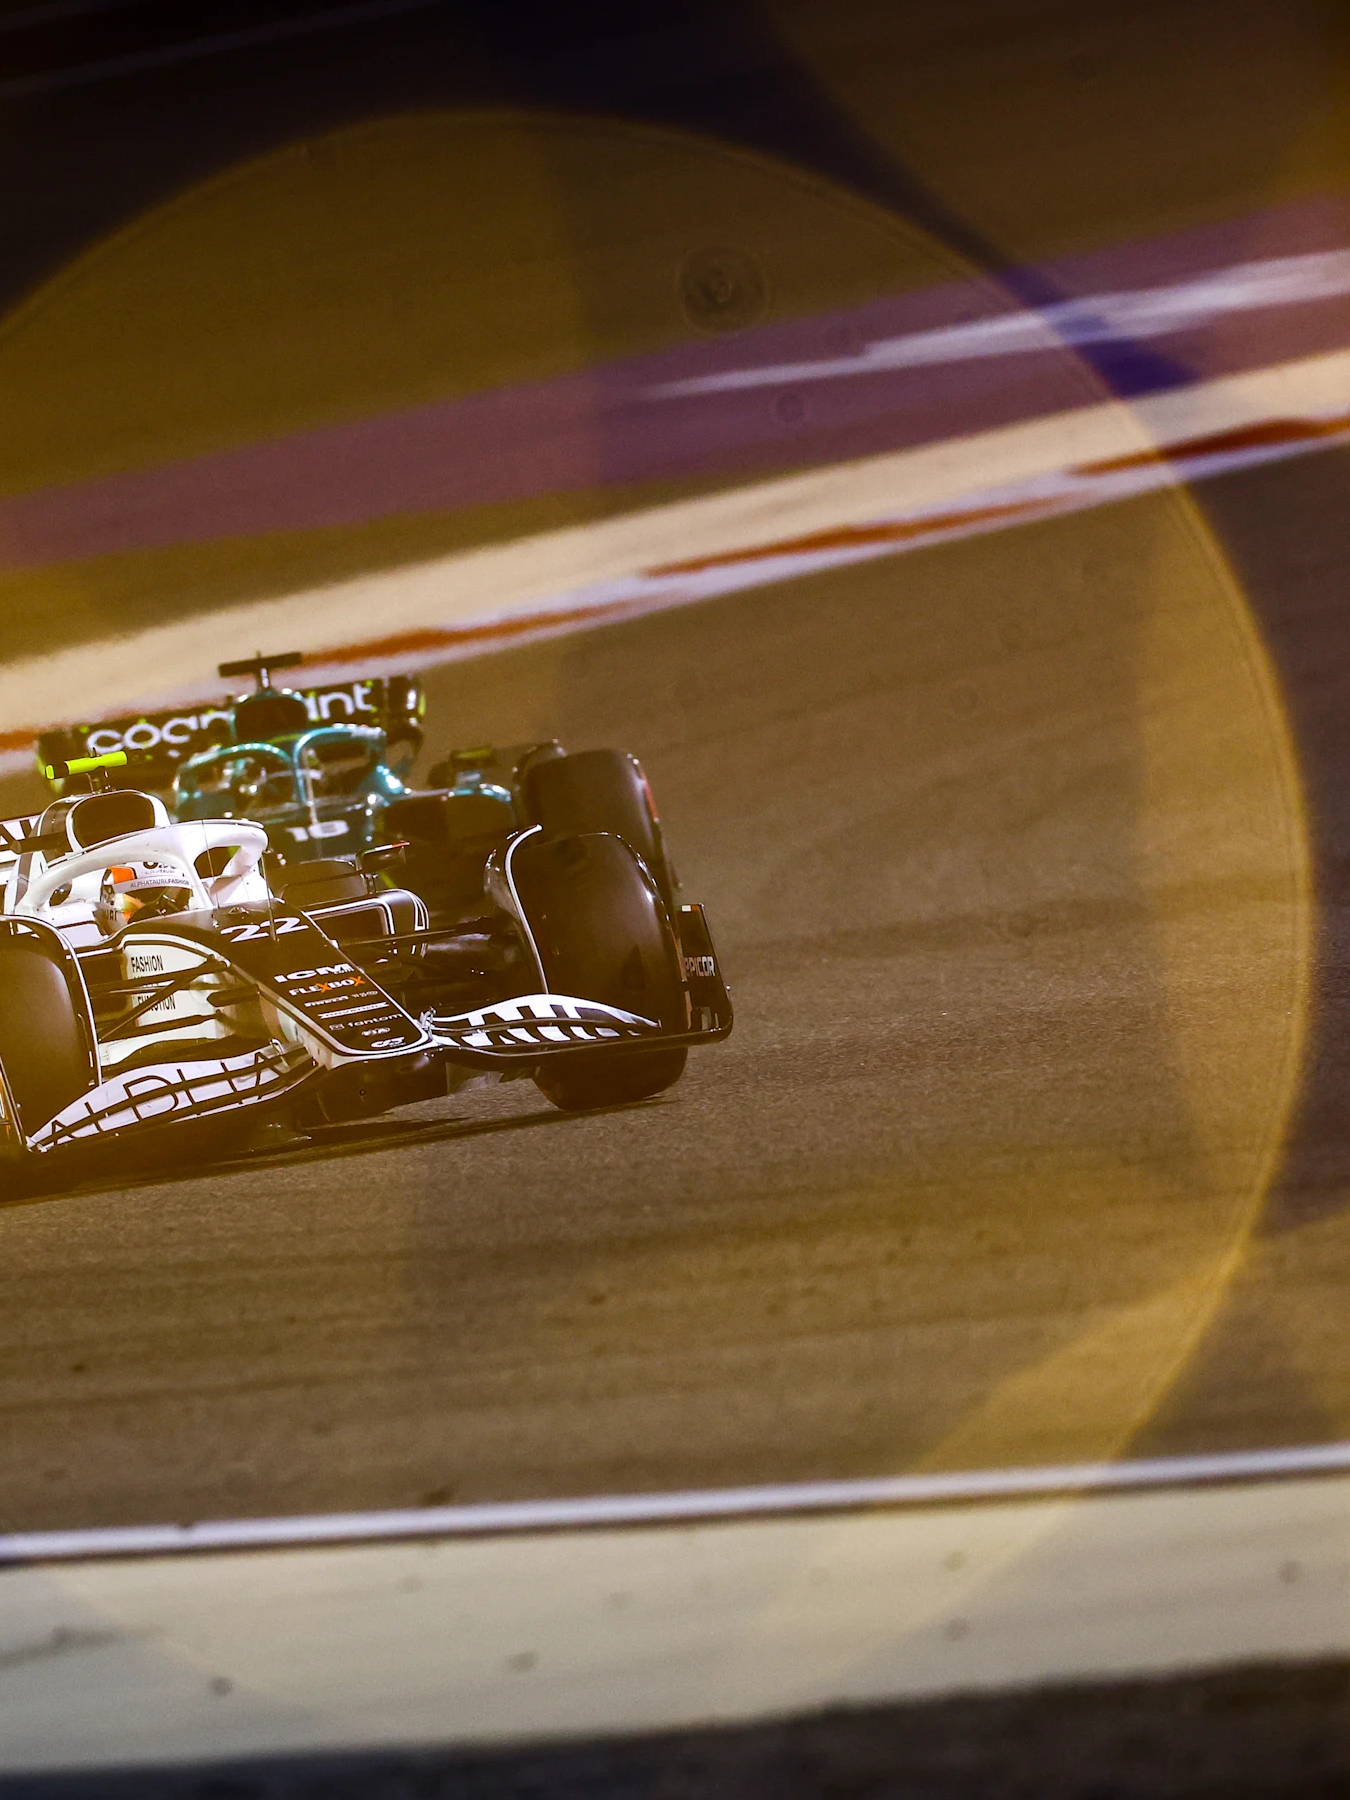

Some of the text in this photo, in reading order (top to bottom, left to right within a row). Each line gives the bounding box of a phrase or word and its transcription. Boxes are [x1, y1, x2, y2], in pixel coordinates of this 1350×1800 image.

[220, 917, 310, 943] 22
[131, 954, 164, 973] FASHION
[274, 963, 352, 983] ICM
[288, 975, 366, 997] FLEXBOX
[347, 1013, 403, 1028] fantom
